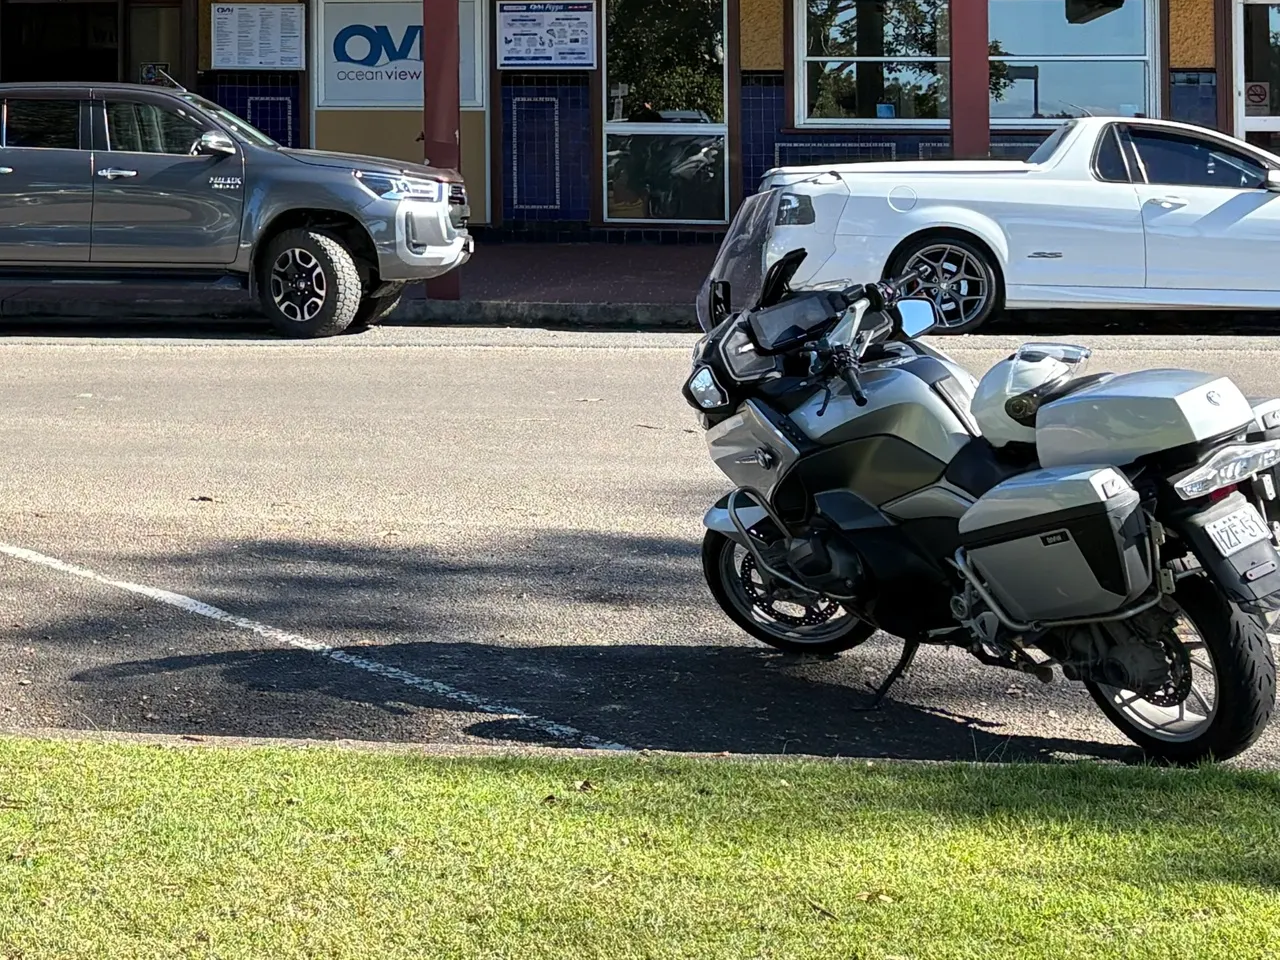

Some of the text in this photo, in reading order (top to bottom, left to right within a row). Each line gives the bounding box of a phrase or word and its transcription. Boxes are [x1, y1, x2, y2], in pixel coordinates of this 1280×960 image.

[333, 24, 424, 67] OV
[337, 67, 423, 81] ocean view
